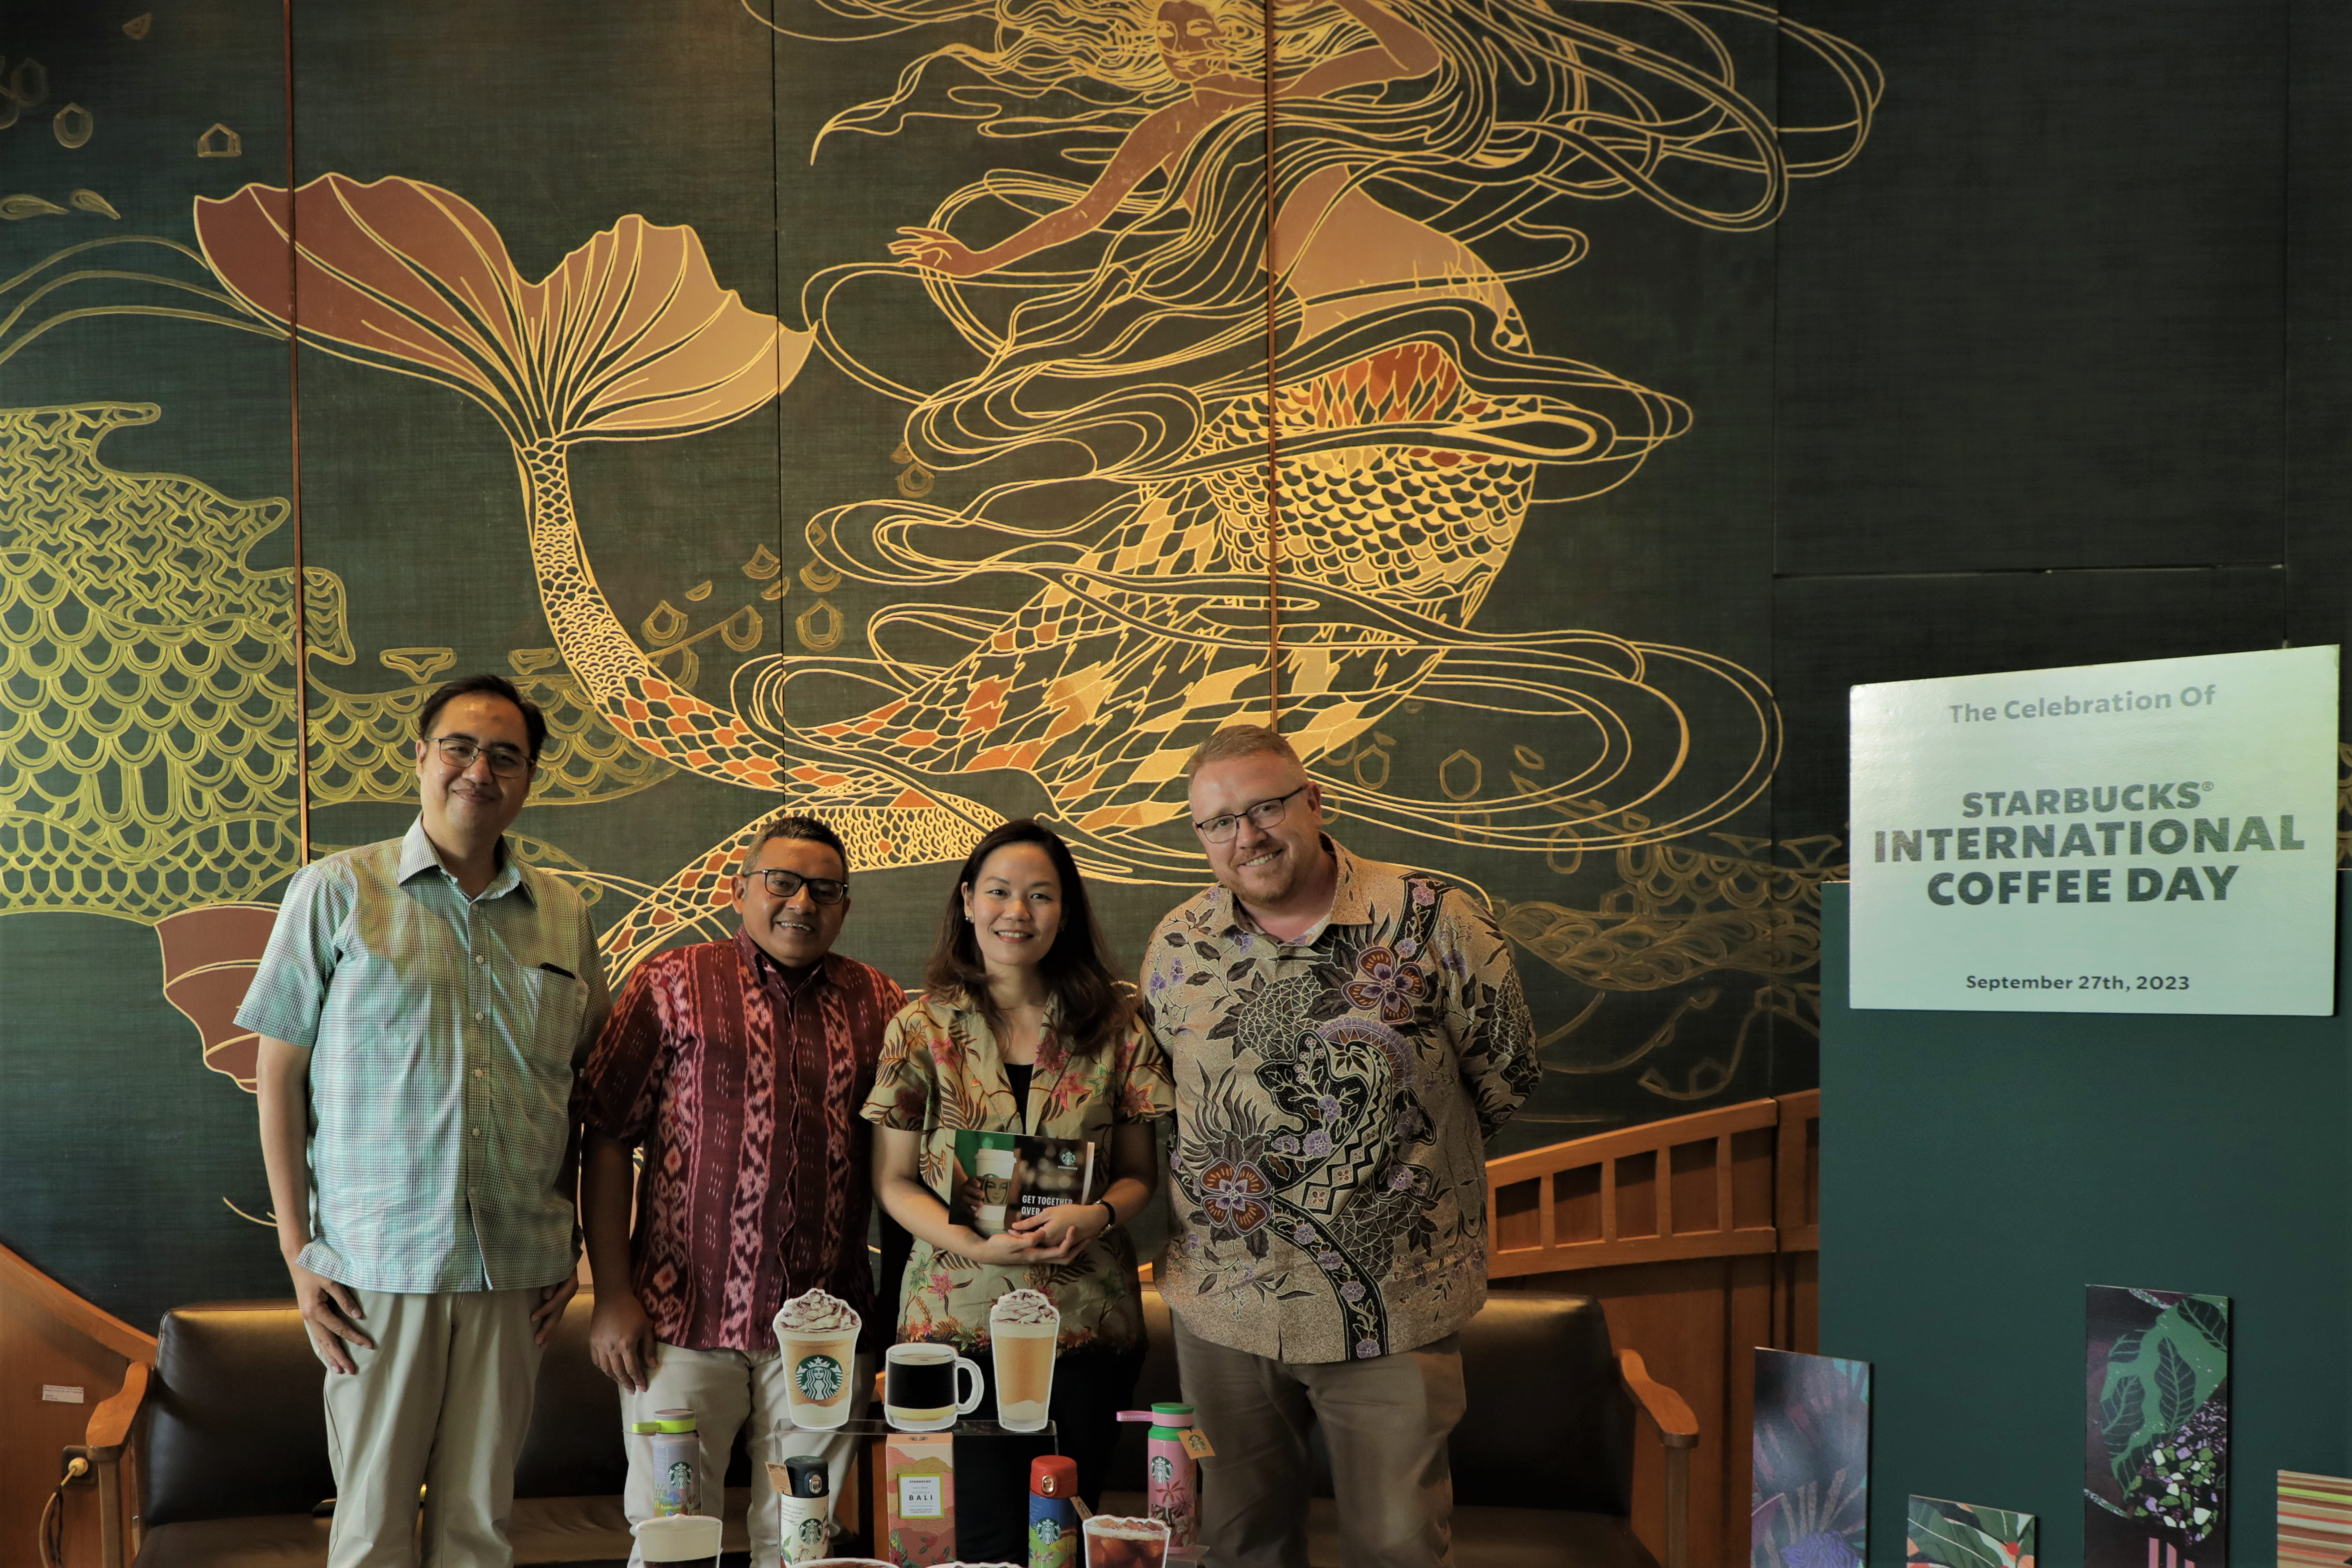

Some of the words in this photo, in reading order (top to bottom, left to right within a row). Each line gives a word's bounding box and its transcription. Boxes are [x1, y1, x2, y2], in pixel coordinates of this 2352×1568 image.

[1949, 703, 1997, 723] The
[2004, 691, 2171, 720] Celebration
[2180, 684, 2216, 707] Of
[1874, 814, 2305, 862] INTERNATIONAL
[1927, 868, 2112, 906] COFFEE
[2127, 865, 2239, 902] DAY
[1966, 975, 2073, 991] September
[2078, 975, 2131, 992] 27th,
[2136, 976, 2190, 990] 2023
[1021, 1206, 1040, 1215] OVER
[1022, 1195, 1036, 1204] GET
